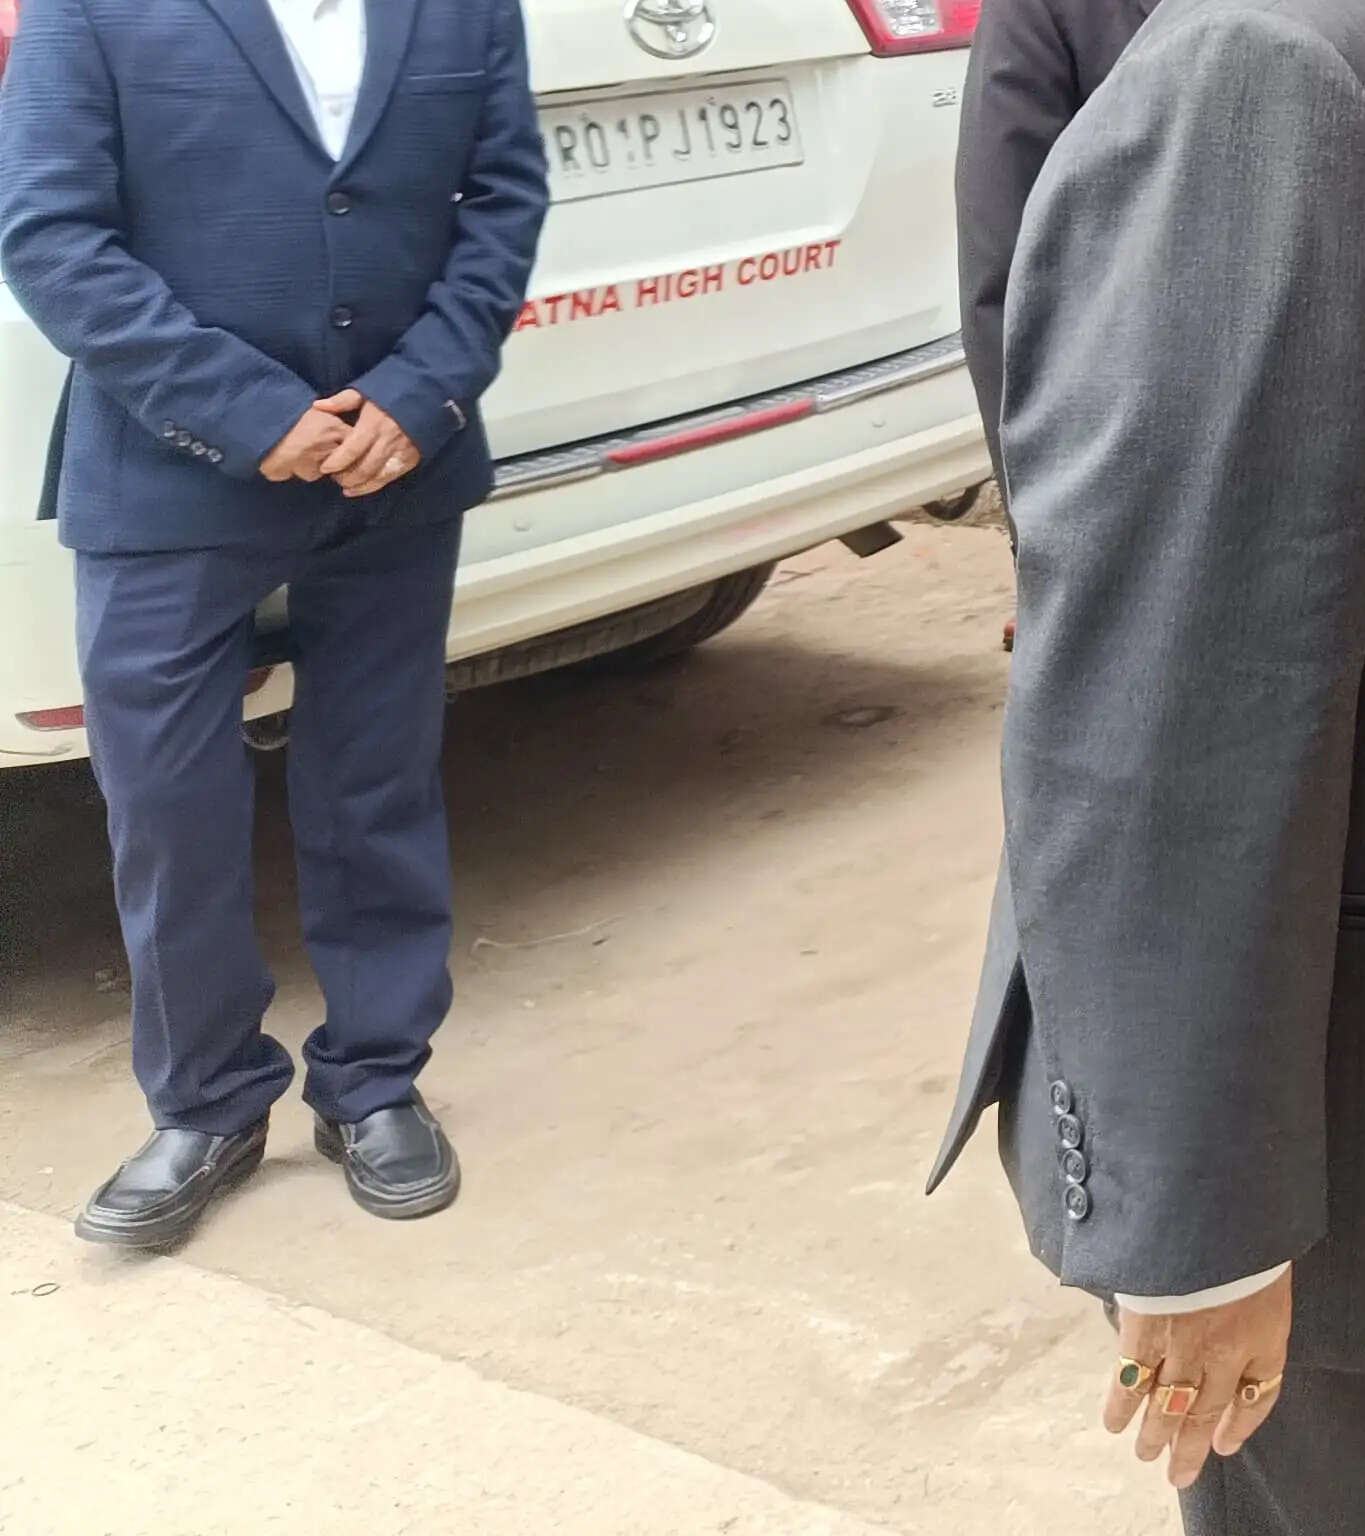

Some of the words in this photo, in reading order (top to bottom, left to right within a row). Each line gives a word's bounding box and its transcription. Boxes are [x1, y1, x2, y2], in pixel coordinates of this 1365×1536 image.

[552, 96, 793, 173] R01PJ1923
[512, 283, 622, 333] ATNA
[635, 262, 725, 309] HIGH
[736, 239, 842, 286] COURT
